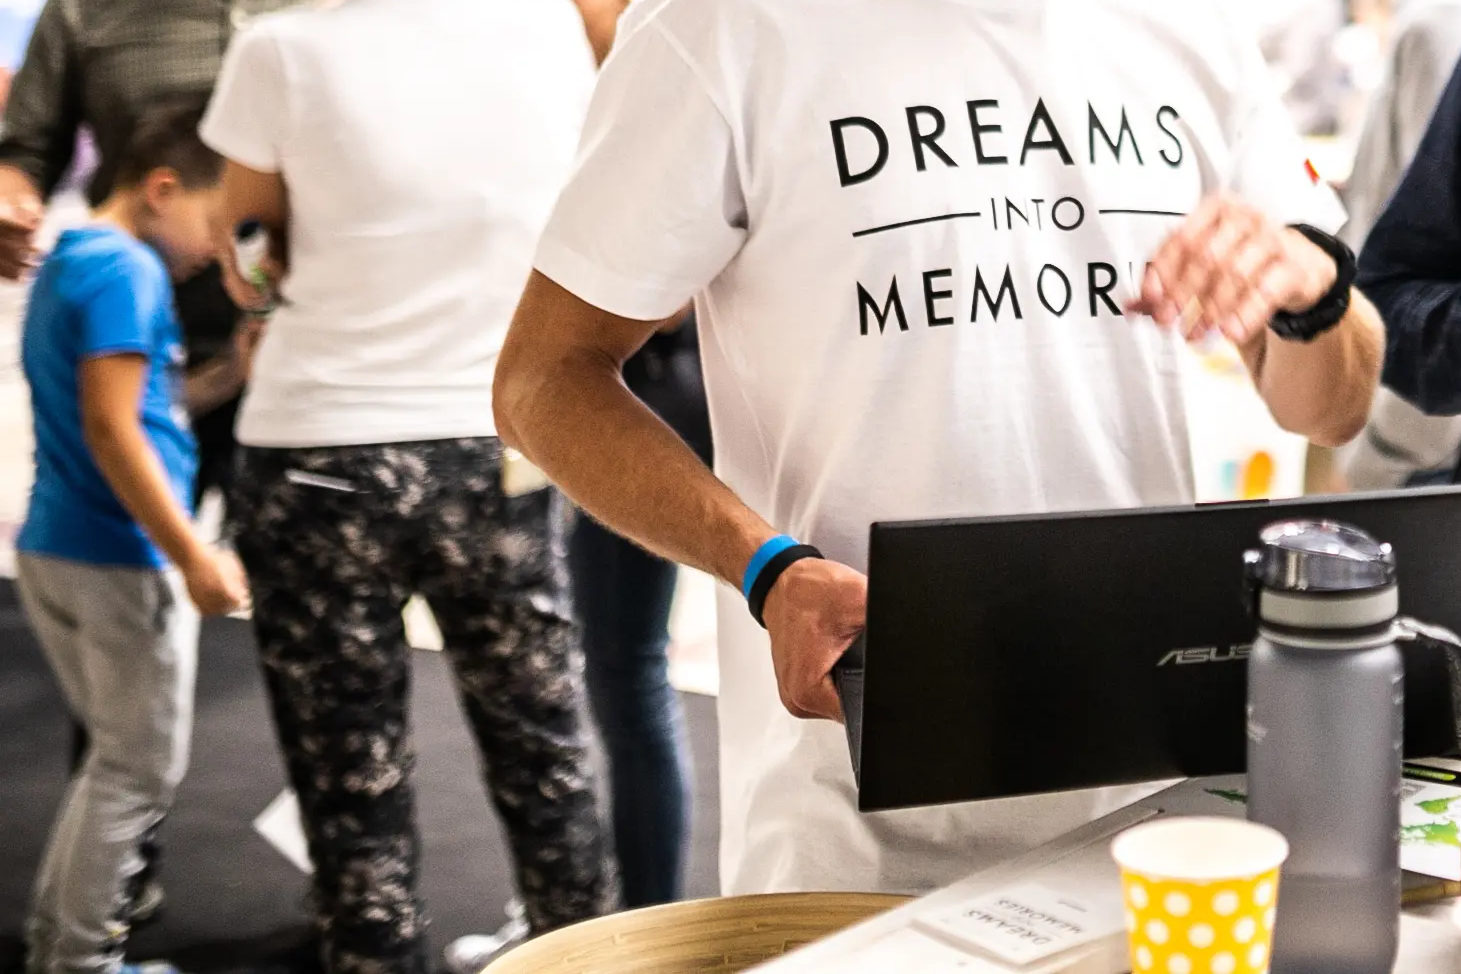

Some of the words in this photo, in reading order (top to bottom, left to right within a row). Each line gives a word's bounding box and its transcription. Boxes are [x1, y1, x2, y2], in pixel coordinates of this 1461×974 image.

[829, 96, 1184, 188] DREAMS
[990, 195, 1086, 232] INTO
[856, 261, 1156, 336] MEMORI
[962, 909, 1053, 945] DREAMS
[993, 898, 1084, 935] MEMORIES
